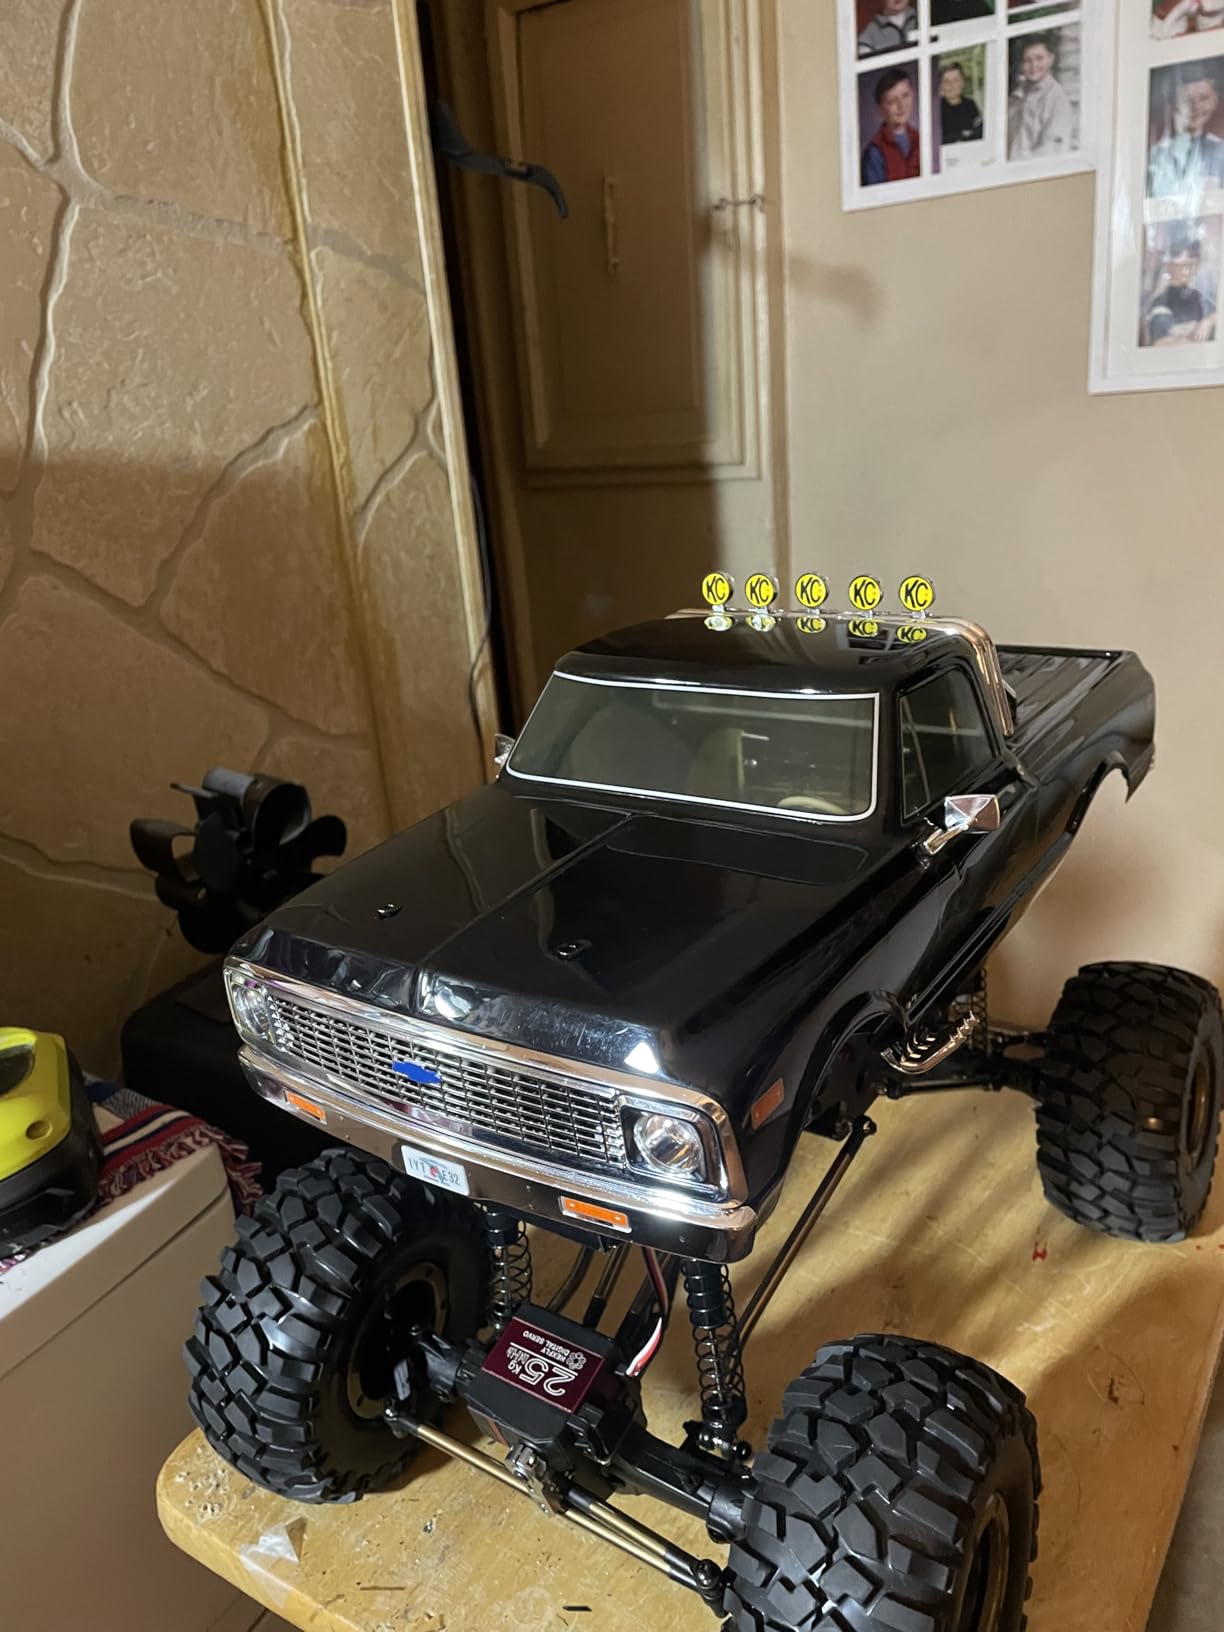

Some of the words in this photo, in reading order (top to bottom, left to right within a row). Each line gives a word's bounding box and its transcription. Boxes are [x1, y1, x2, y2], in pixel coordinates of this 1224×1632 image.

[706, 577, 726, 602] KC
[750, 577, 770, 604] KC
[800, 576, 821, 604] KC
[854, 579, 876, 607] KC
[904, 579, 928, 607] KC
[522, 1330, 545, 1345] SERVO
[545, 1340, 571, 1356] DIGITAL
[540, 1346, 567, 1362] HEXFLY
[519, 1357, 576, 1396] 25
